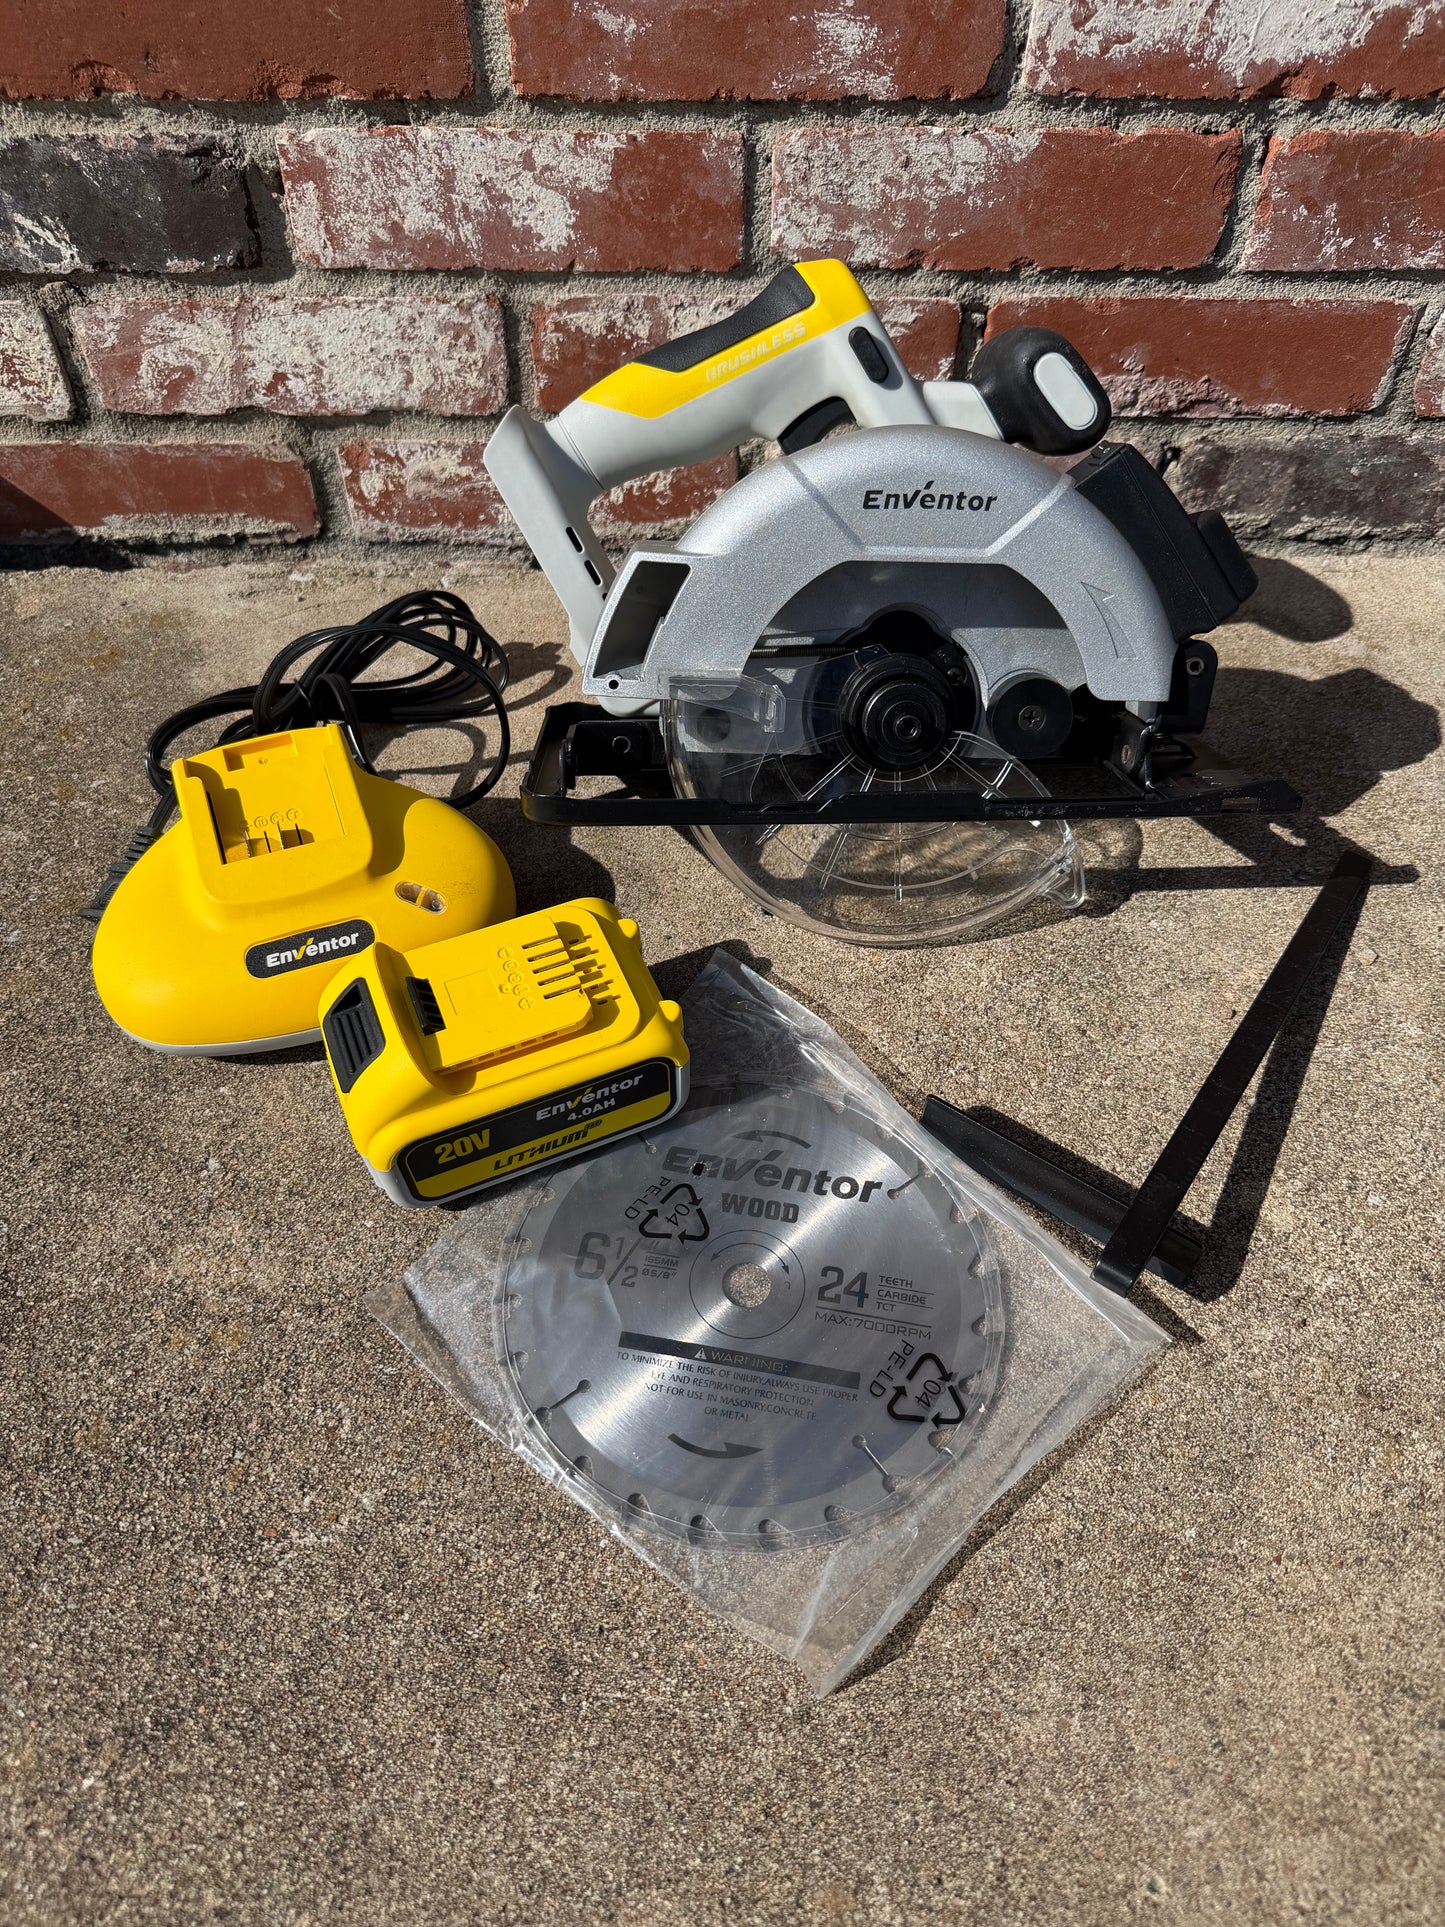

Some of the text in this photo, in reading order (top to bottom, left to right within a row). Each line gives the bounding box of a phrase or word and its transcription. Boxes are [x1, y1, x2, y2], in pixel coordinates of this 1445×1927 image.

[567, 1098, 616, 1122] 4.0AH
[433, 1128, 491, 1165] 20V
[624, 1175, 672, 1220] PE-LD
[720, 1192, 800, 1224] WOOD
[665, 1203, 691, 1227] 04
[817, 1265, 870, 1309] 24
[878, 1275, 914, 1289] TEETH
[875, 1301, 897, 1313] TCT
[877, 1289, 928, 1305] CARBIDE
[616, 1351, 630, 1361] TO
[631, 1353, 675, 1369] MINIMIZE
[677, 1361, 695, 1373] THE
[696, 1365, 718, 1377] RISK
[718, 1369, 732, 1378] OF
[802, 1384, 820, 1395] USE
[822, 1388, 859, 1402] PROPER
[869, 1339, 916, 1398] PE-LD
[666, 1385, 685, 1397] FOR
[687, 1390, 704, 1401] USE
[707, 1393, 719, 1402] IN
[668, 1374, 691, 1385] AND
[692, 1378, 753, 1396] RESPIRATORY
[914, 1379, 942, 1408] 04
[704, 1406, 718, 1416] OR
